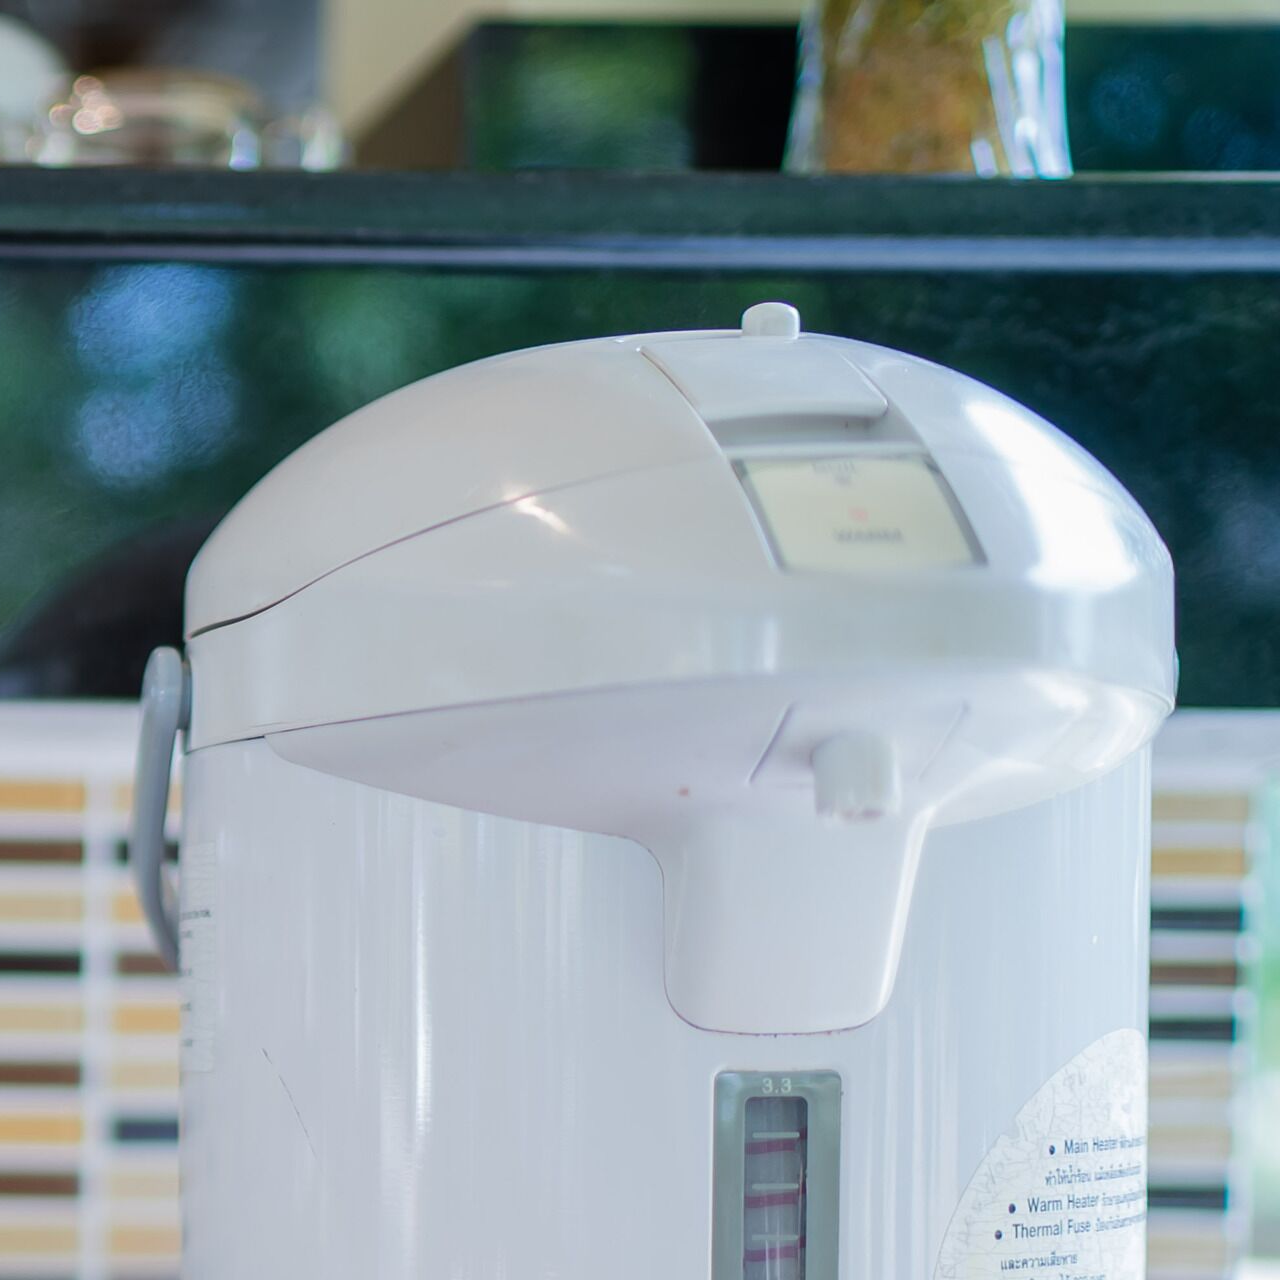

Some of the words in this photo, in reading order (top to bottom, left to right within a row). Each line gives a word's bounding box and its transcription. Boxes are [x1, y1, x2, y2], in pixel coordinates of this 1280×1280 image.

[1064, 1138, 1089, 1155] Main
[1027, 1197, 1063, 1214] Warm
[1067, 1193, 1099, 1210] Heater
[1012, 1219, 1063, 1240] Thermal
[1067, 1218, 1092, 1235] Fuse
